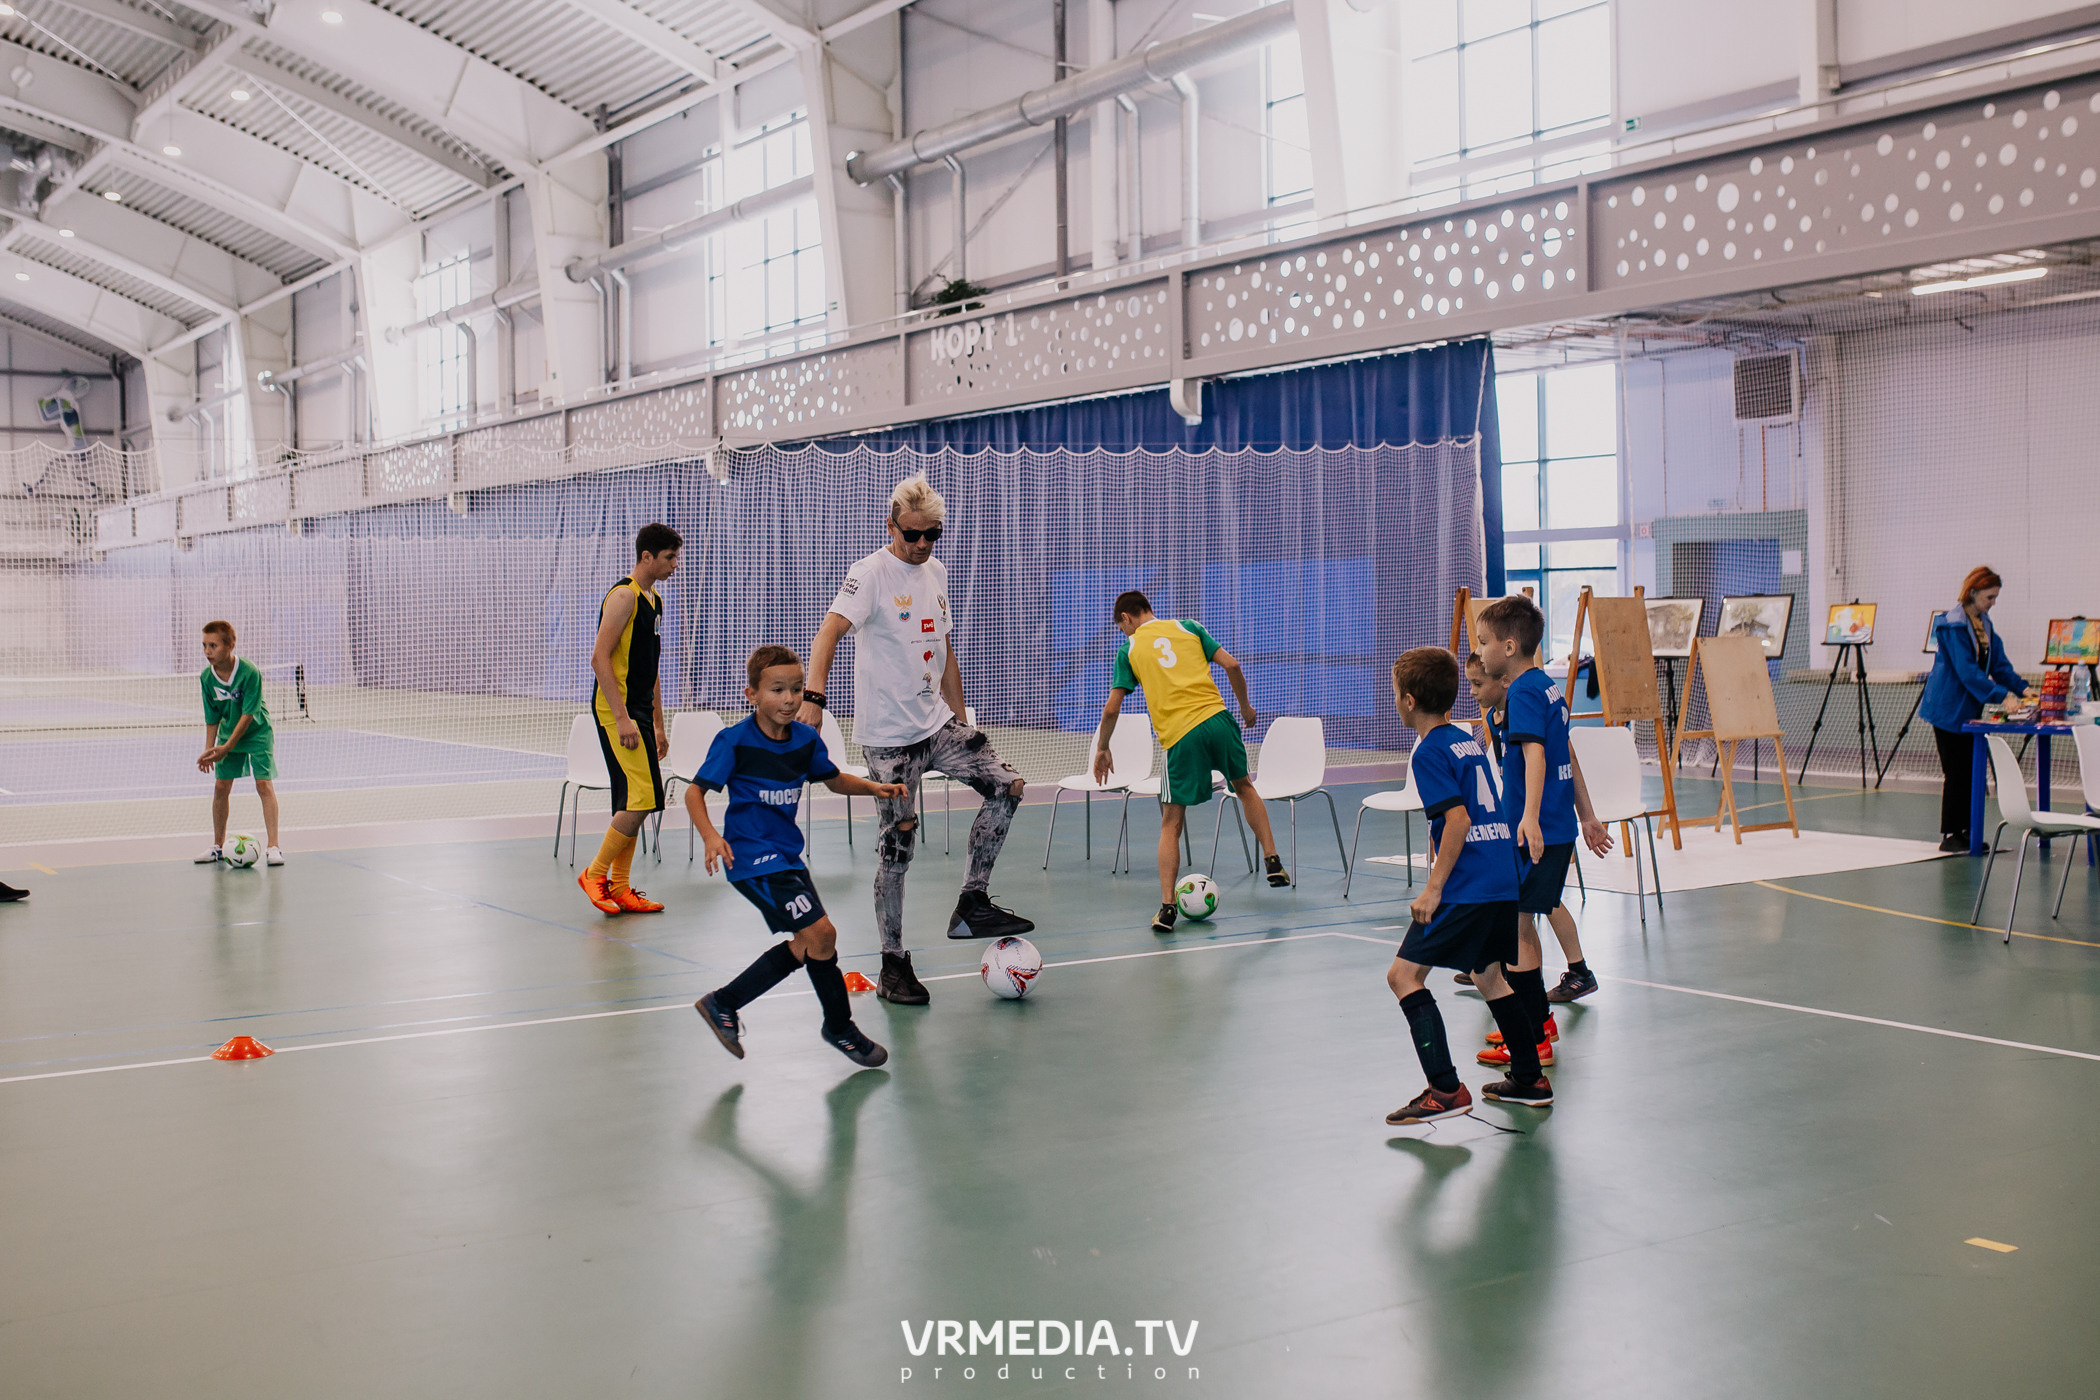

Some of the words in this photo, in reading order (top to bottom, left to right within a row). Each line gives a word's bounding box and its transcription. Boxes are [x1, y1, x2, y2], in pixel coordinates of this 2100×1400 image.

[931, 316, 996, 361] КОРТ
[1005, 312, 1019, 347] 1
[1153, 636, 1178, 668] 3
[785, 894, 812, 920] 20
